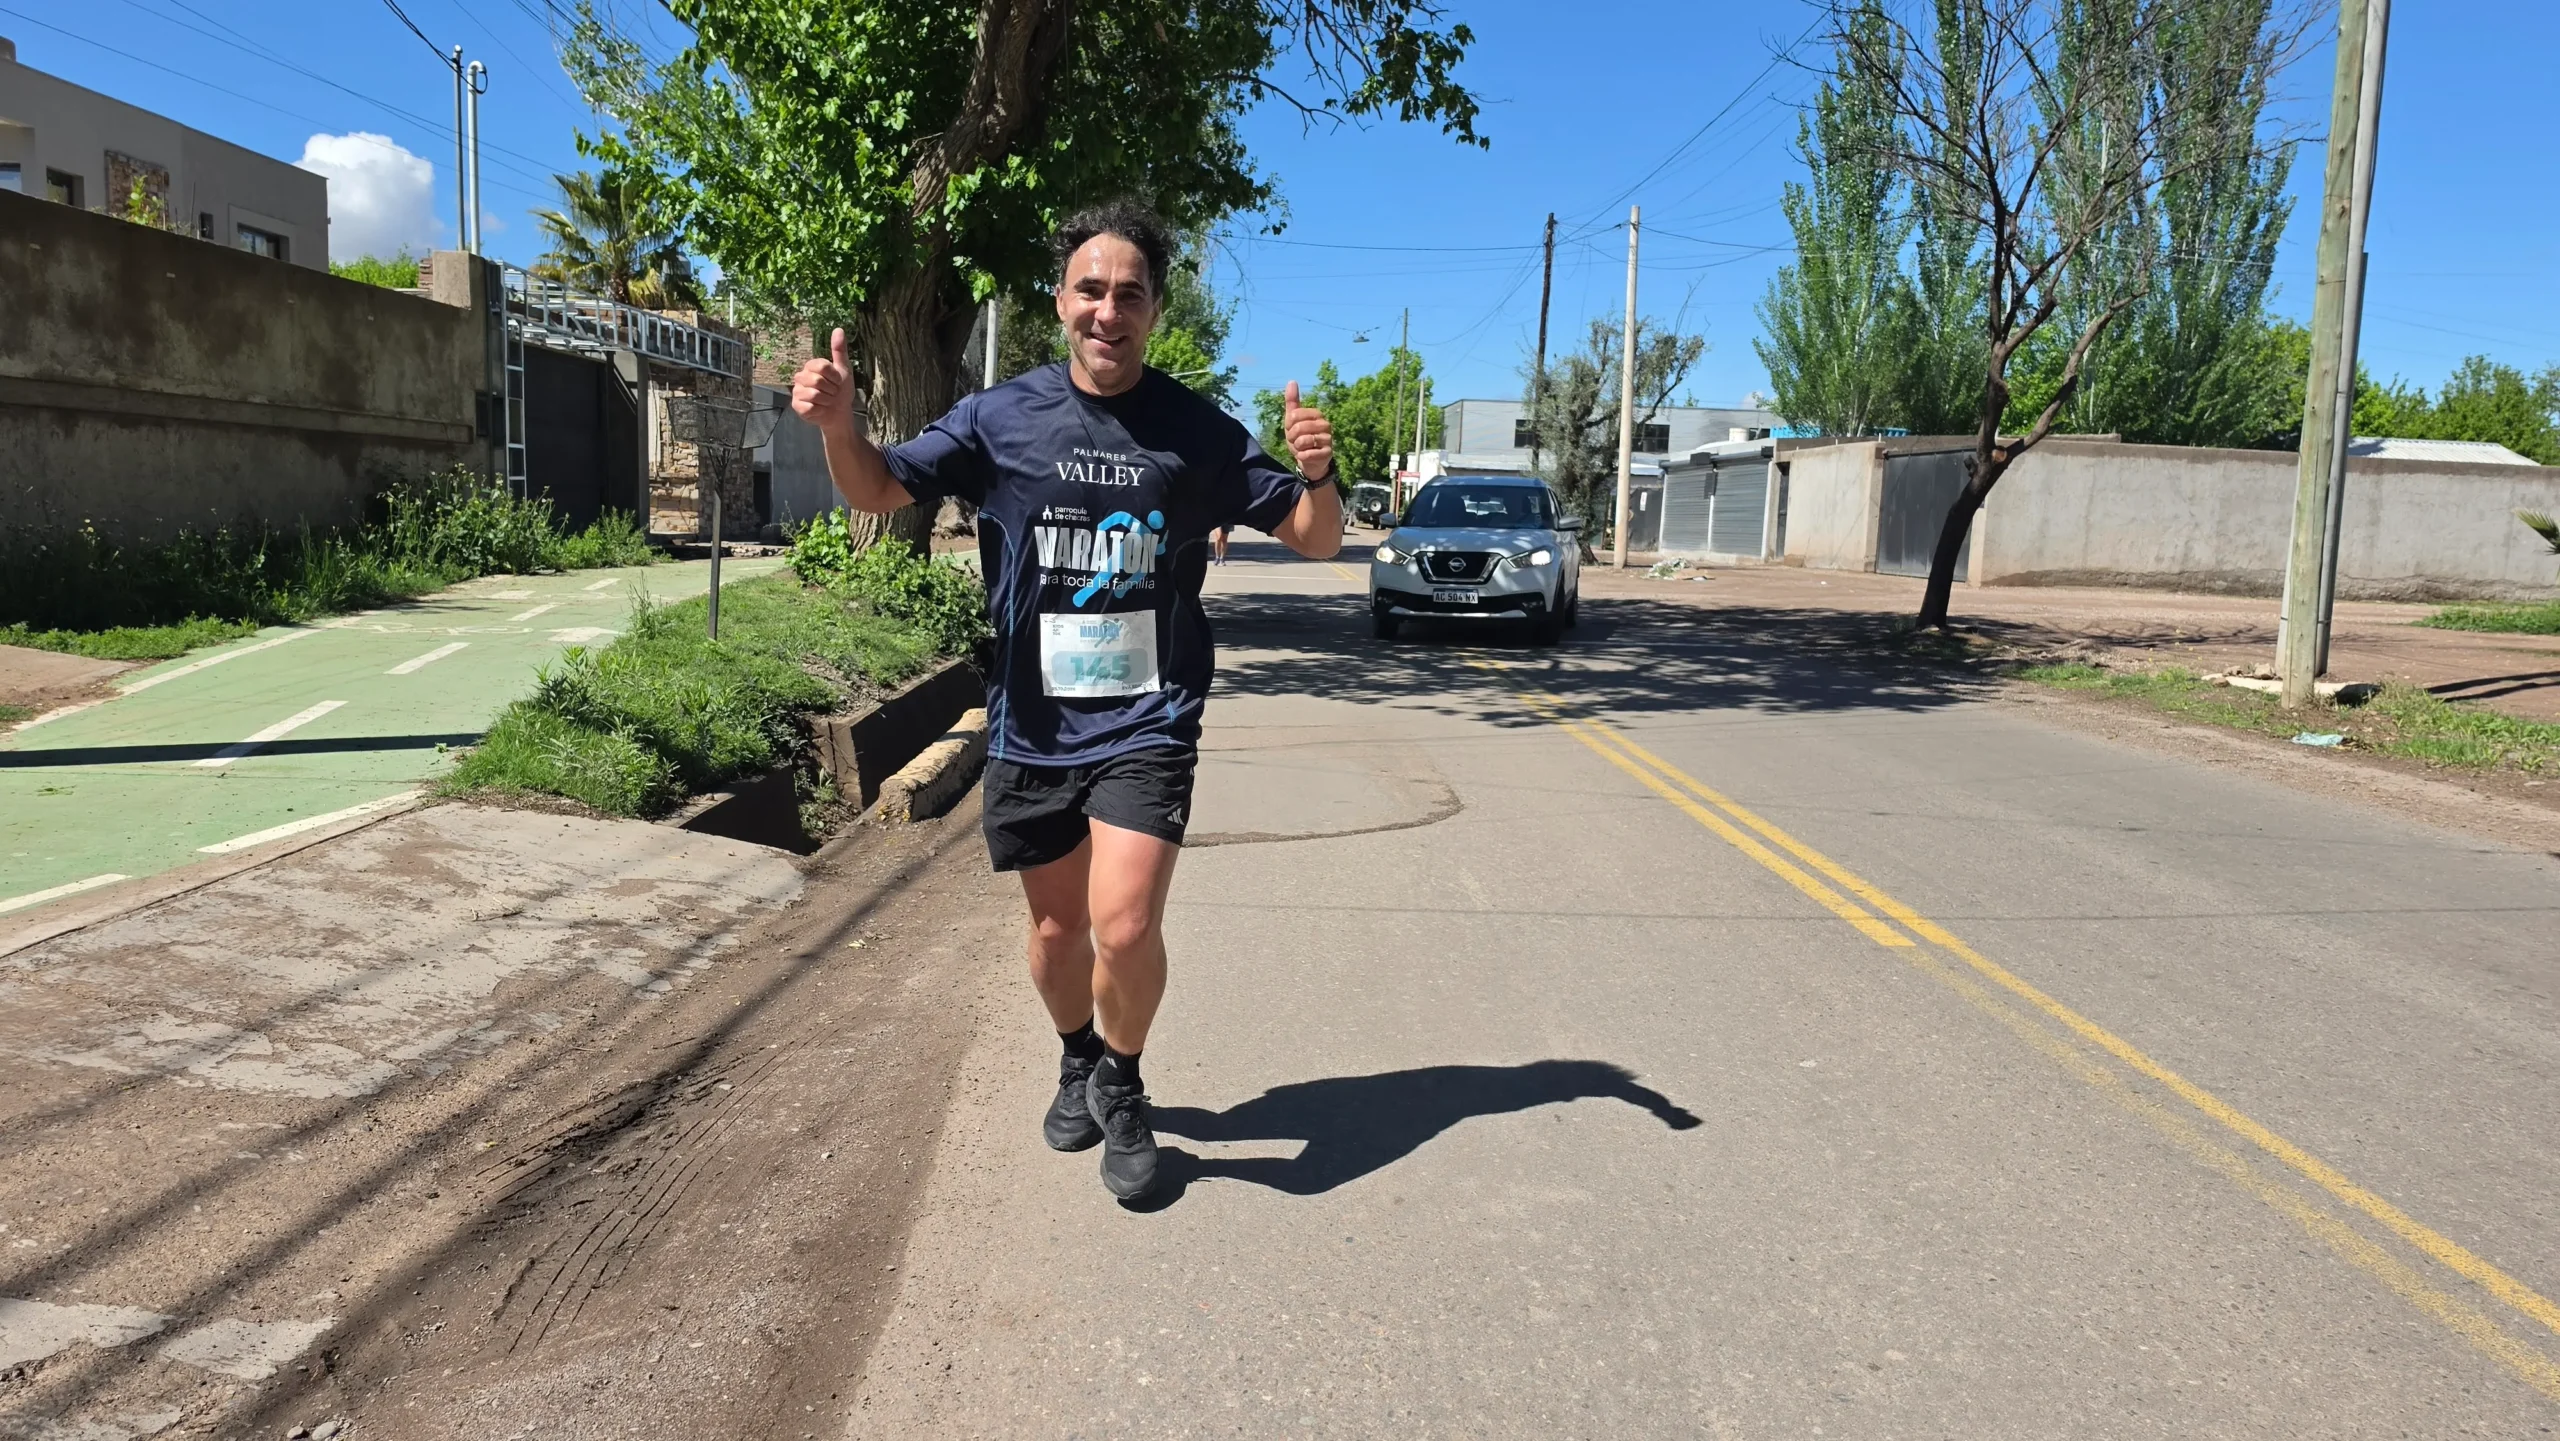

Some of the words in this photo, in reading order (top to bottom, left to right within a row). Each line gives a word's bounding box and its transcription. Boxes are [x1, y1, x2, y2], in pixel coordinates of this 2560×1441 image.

[1073, 448, 1127, 461] PALMARES
[1056, 462, 1145, 486] VALLEY
[1055, 507, 1087, 515] parroquia
[1062, 574, 1094, 588] toda
[1098, 576, 1110, 589] la
[1112, 577, 1155, 590] familia
[1436, 593, 1446, 601] AC
[1448, 593, 1463, 601] 504
[1466, 594, 1476, 602] NX
